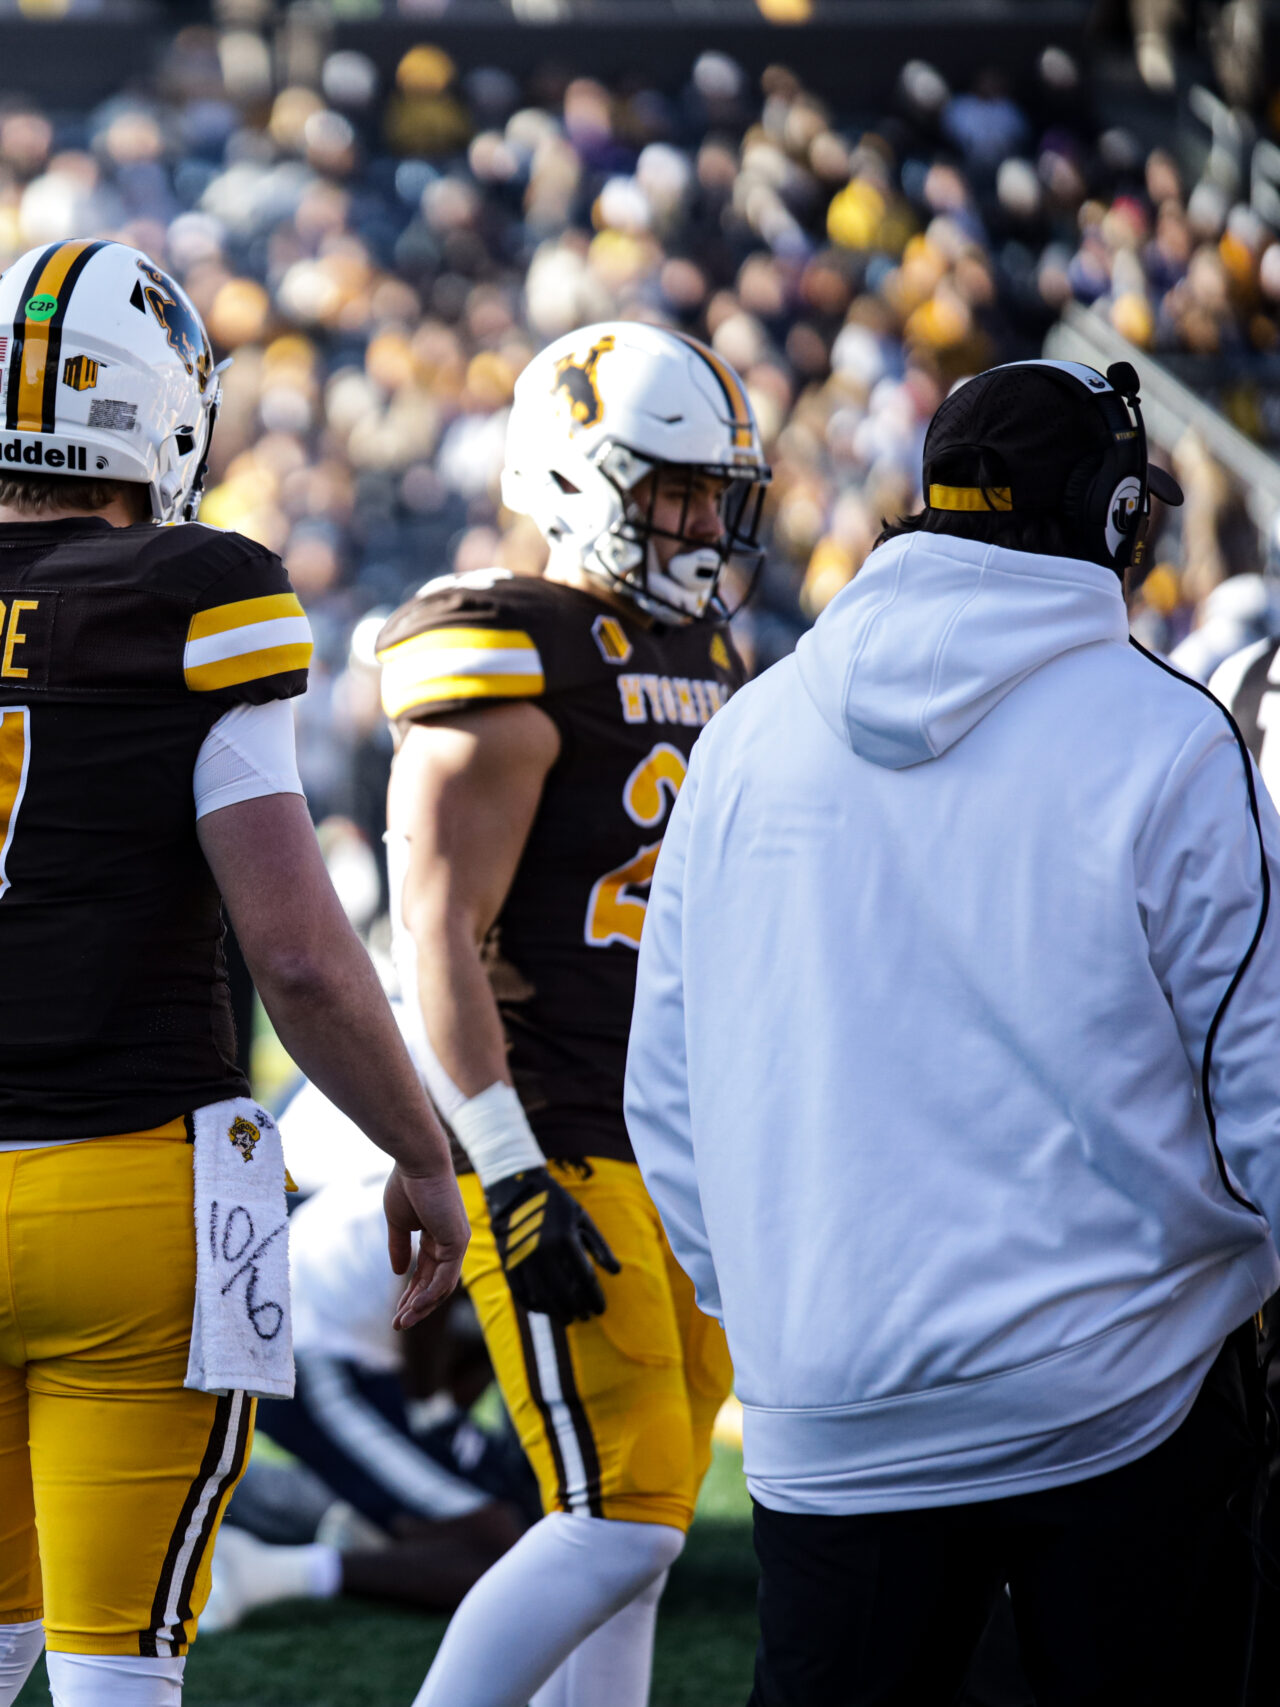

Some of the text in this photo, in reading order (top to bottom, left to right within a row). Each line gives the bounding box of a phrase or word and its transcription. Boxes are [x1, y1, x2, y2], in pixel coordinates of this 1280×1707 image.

[28, 301, 55, 312] C2P
[584, 742, 689, 951] 2
[210, 1200, 288, 1340] 10/6
